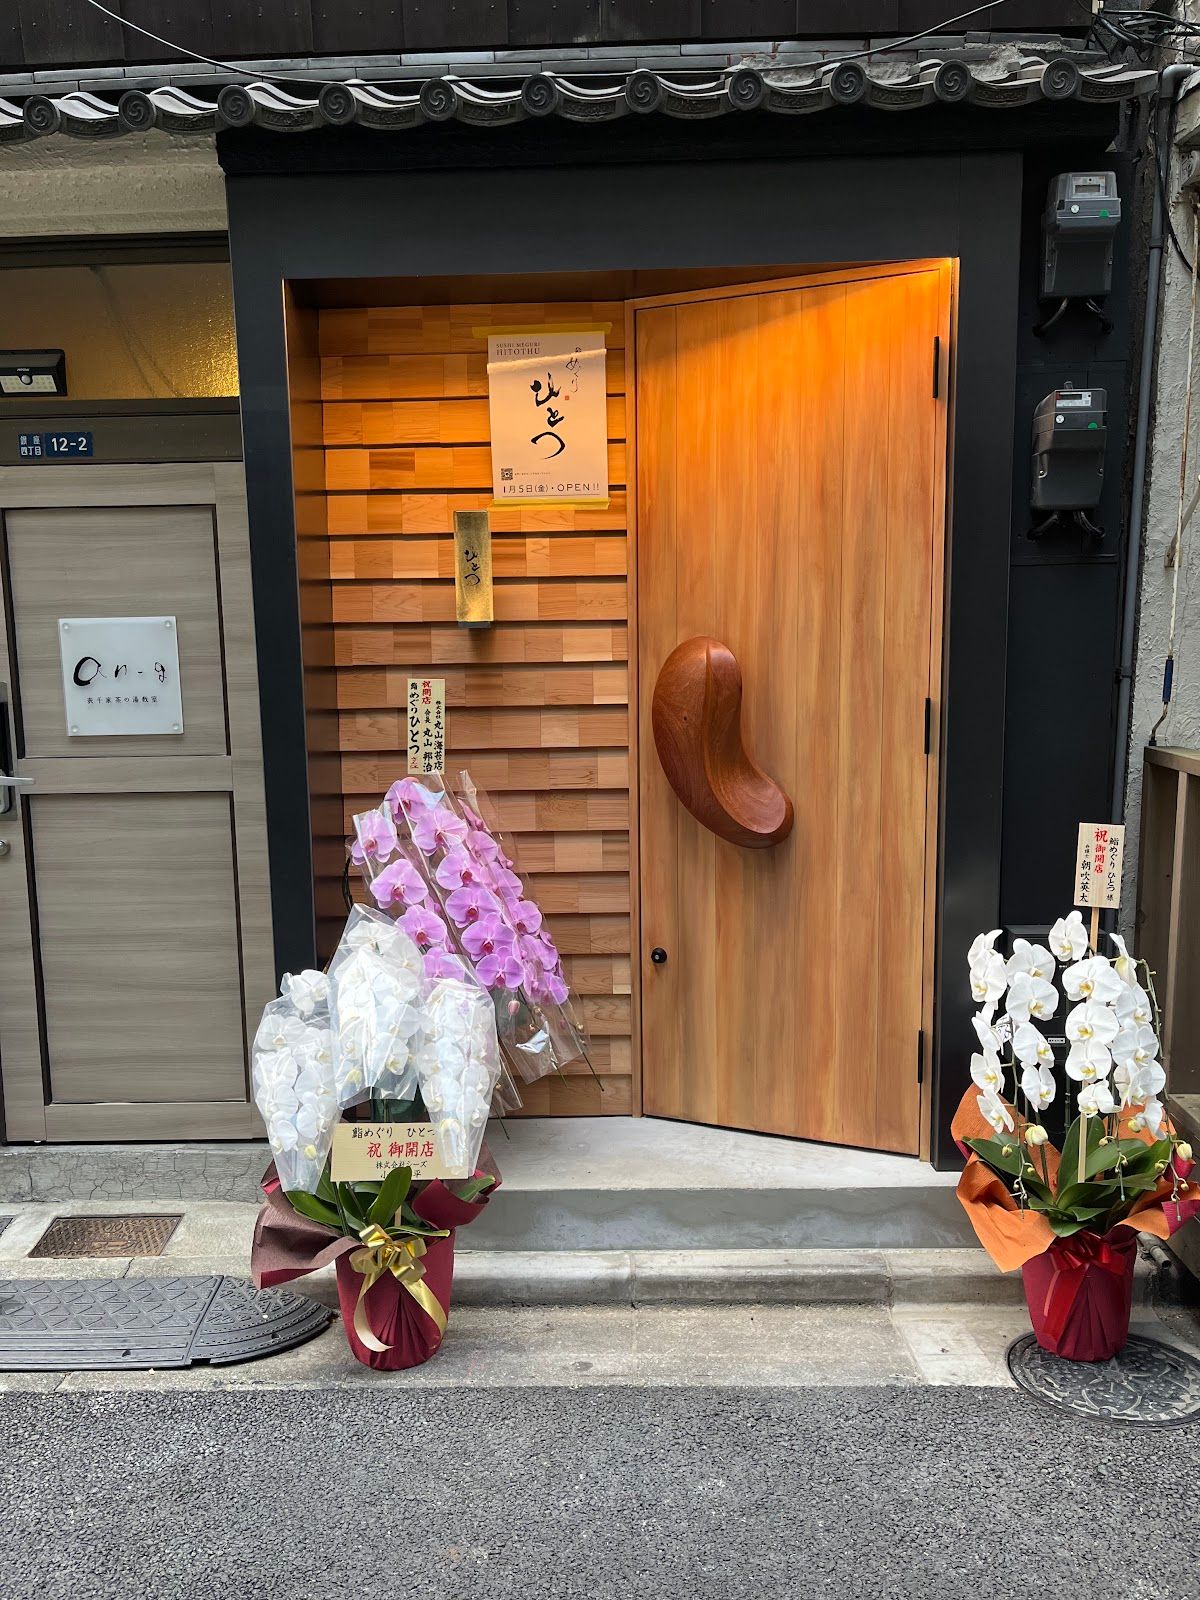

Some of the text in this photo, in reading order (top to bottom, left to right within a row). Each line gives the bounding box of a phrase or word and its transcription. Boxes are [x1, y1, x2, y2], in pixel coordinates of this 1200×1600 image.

[496, 348, 540, 356] HITOTHU
[530, 372, 566, 460] ひとつ
[51, 437, 88, 452] 12-2
[464, 546, 480, 586] ひとつ
[422, 681, 431, 705] 祝開店
[352, 1127, 393, 1139] 鮨めぐり
